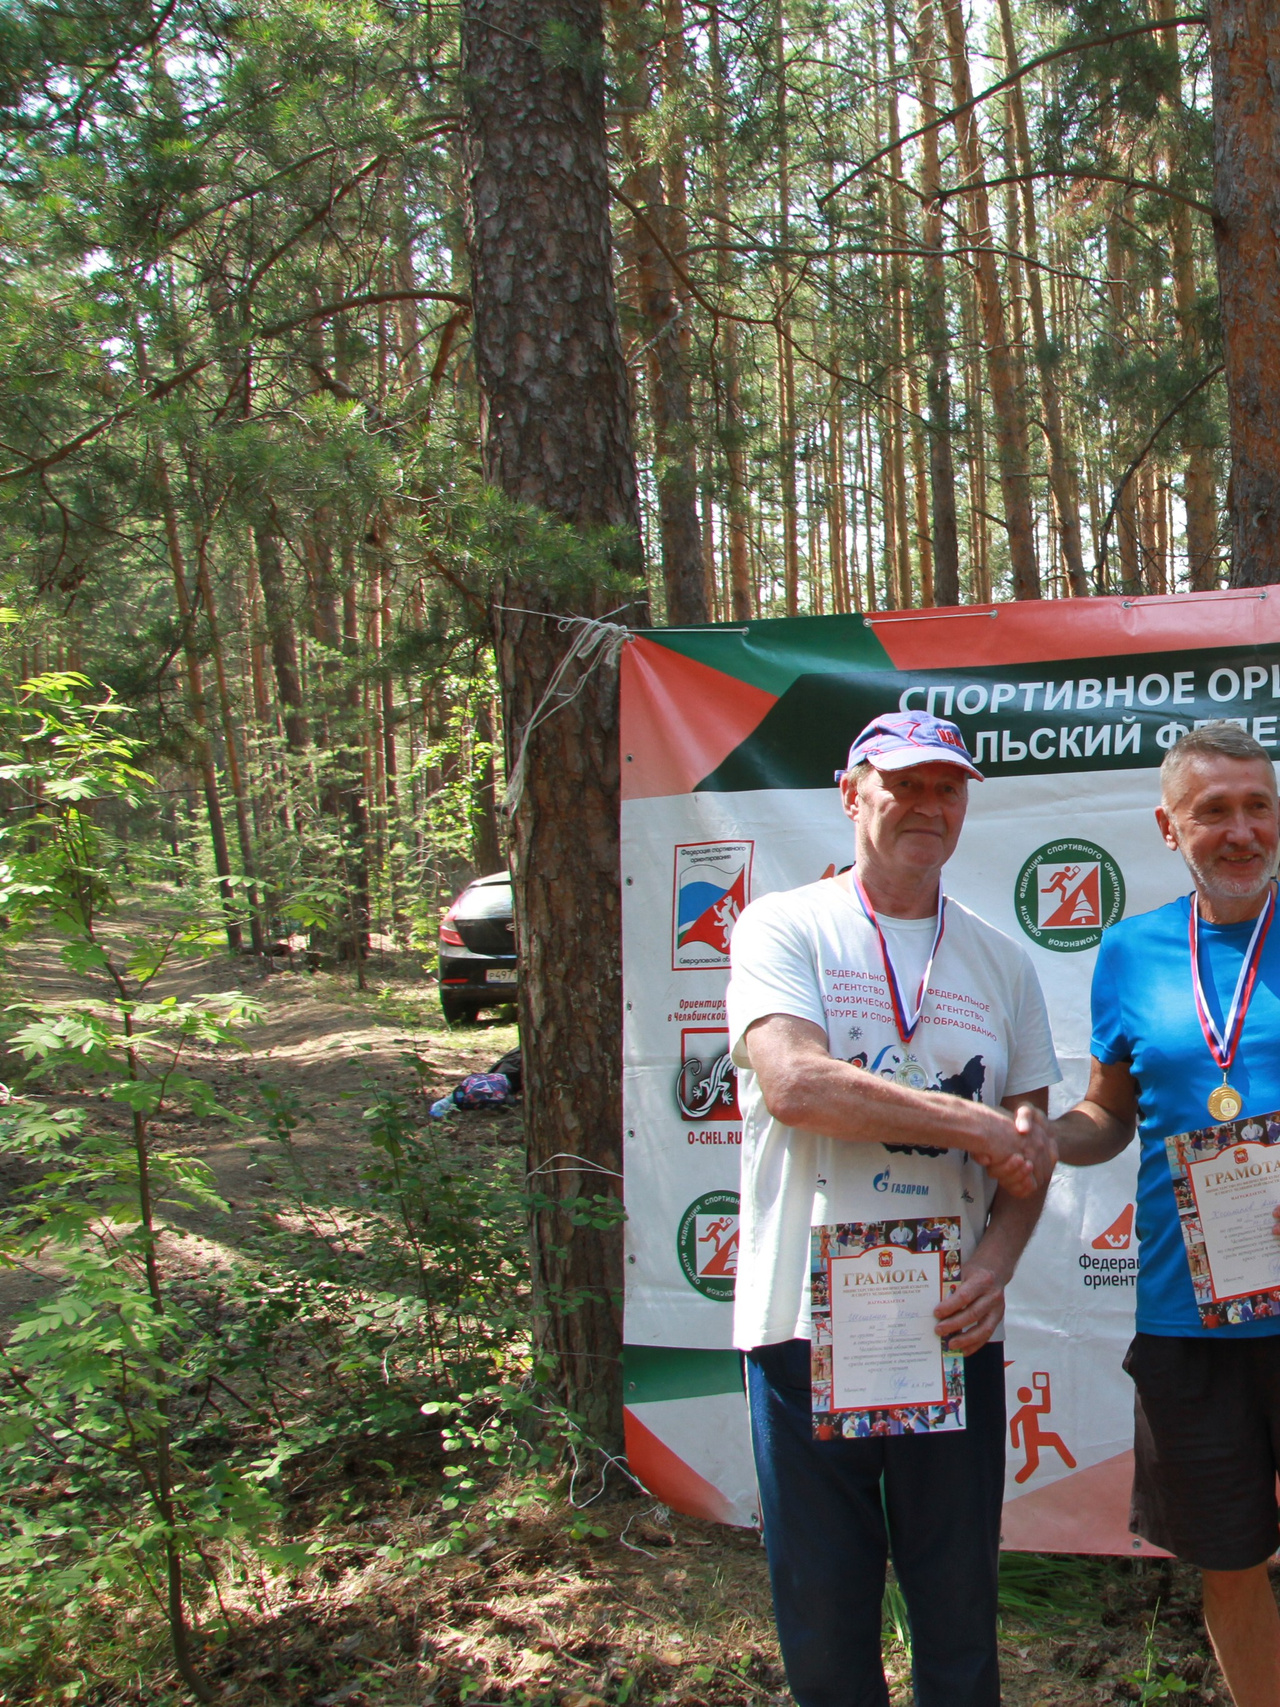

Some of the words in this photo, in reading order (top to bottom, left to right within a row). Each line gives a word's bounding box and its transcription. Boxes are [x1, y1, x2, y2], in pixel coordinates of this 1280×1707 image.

[899, 671, 1196, 716] СПОРТИВНОЕ
[972, 716, 1142, 765] ЛЬСКИЙ
[1047, 843, 1102, 860] СПОРТИВНОГО
[1019, 854, 1044, 898] ФЕДЕРАЦИЯ
[1020, 905, 1042, 937] ОБЛАСТИ
[1048, 934, 1098, 948] ТЮМЕНСКОЙ
[824, 969, 888, 983] ФЕДЕРАЛЬНО
[832, 983, 885, 996] АГЕНТСТВО
[679, 999, 727, 1011] Ориентиро
[926, 987, 991, 1013] ФЕДЕРАЛЬНОЕ
[667, 1014, 673, 1022] в
[674, 1010, 727, 1022] Челябинской
[824, 1008, 858, 1019] ЛЬТУРЕ
[861, 1010, 868, 1019] И
[870, 1011, 897, 1028] СПОРТ
[935, 1003, 985, 1023] АГЕНТСТВО
[920, 1015, 931, 1024] ПО
[933, 1016, 998, 1042] ОБРАЗОВАНИЮ
[687, 1131, 743, 1145] O-CHEL.RU
[891, 1183, 929, 1196] ГАЗПРОМ
[681, 1204, 702, 1246] ФЕДЕРАЦИЯ
[704, 1195, 739, 1206] СПОРТИВН
[681, 1252, 701, 1285] ОБЛАСТИ
[1079, 1253, 1140, 1273] Федера
[842, 1268, 929, 1287] ГРАМОТА
